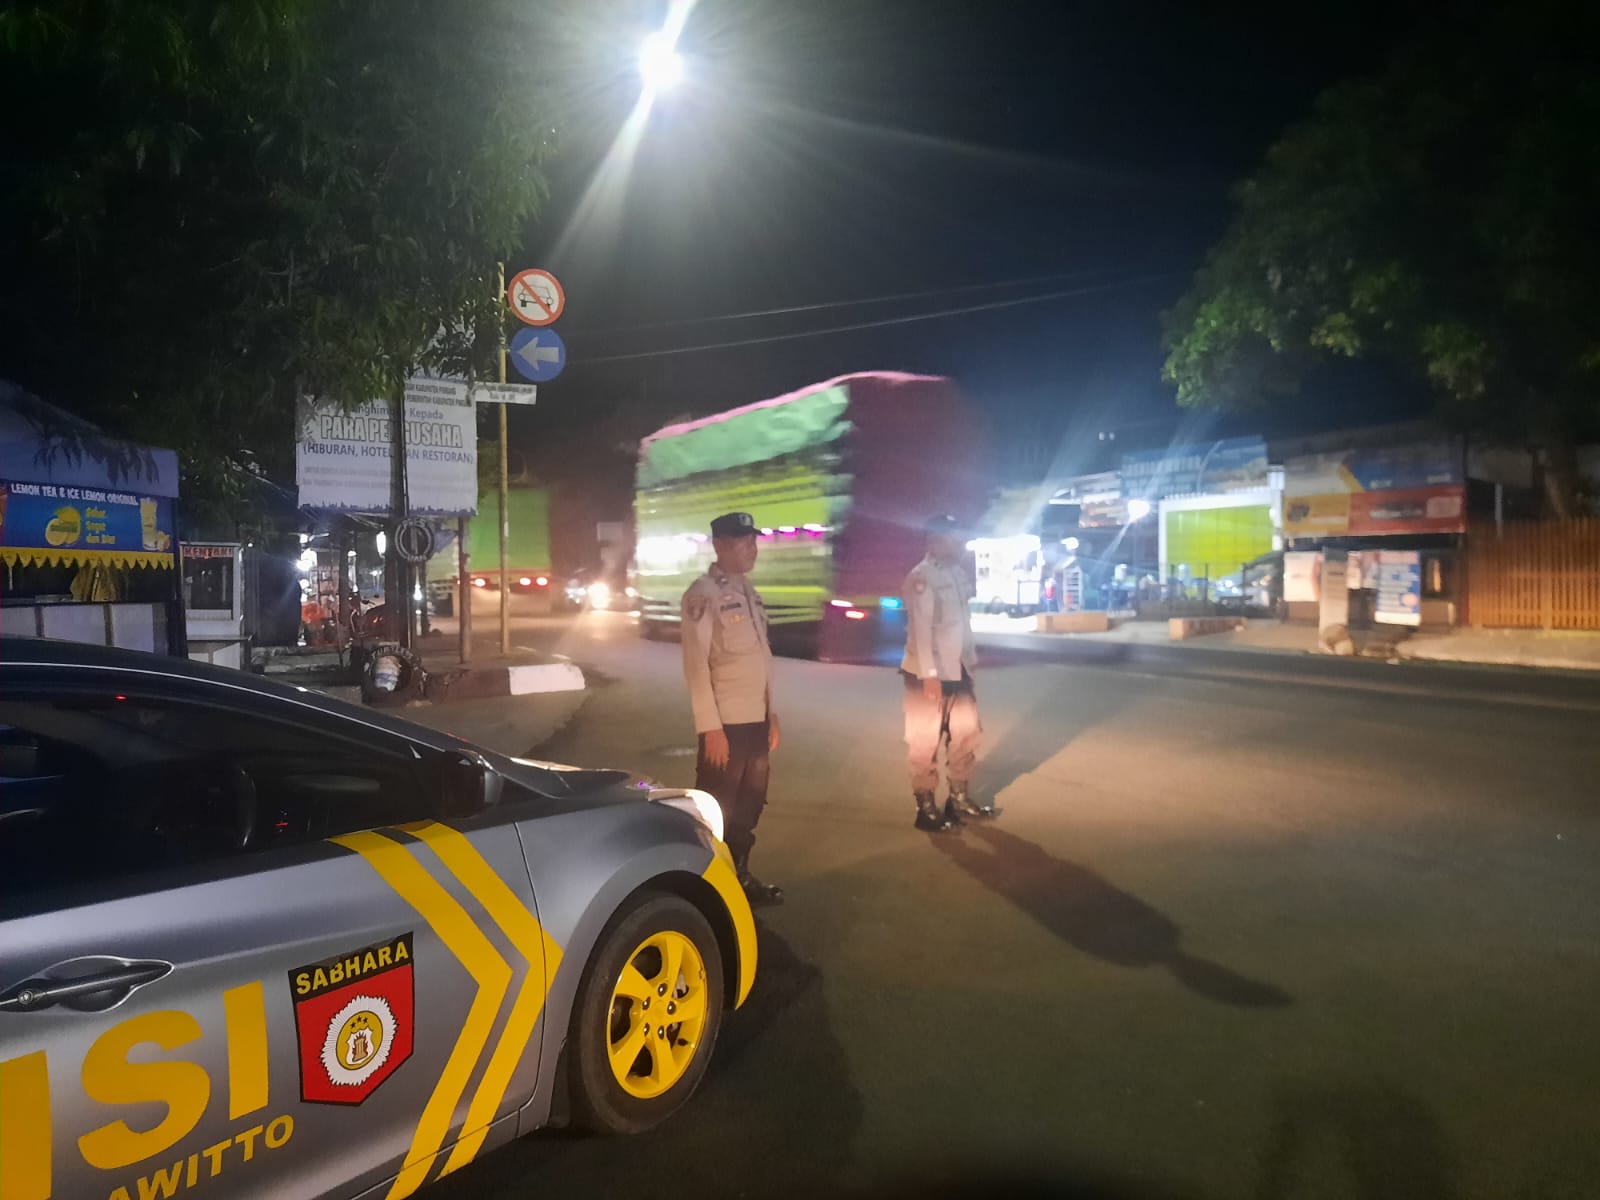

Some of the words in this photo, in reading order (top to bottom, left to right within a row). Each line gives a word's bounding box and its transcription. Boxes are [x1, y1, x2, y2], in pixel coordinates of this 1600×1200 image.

[410, 407, 443, 420] Kepada
[320, 414, 367, 442] PARA
[368, 417, 463, 449] PEGUSAHA
[11, 483, 40, 496] LEMON
[42, 486, 58, 498] TEA
[67, 488, 80, 500] ICE
[81, 490, 107, 503] LEMON
[107, 491, 139, 506] ORIGINAL
[296, 941, 409, 995] SABHARA
